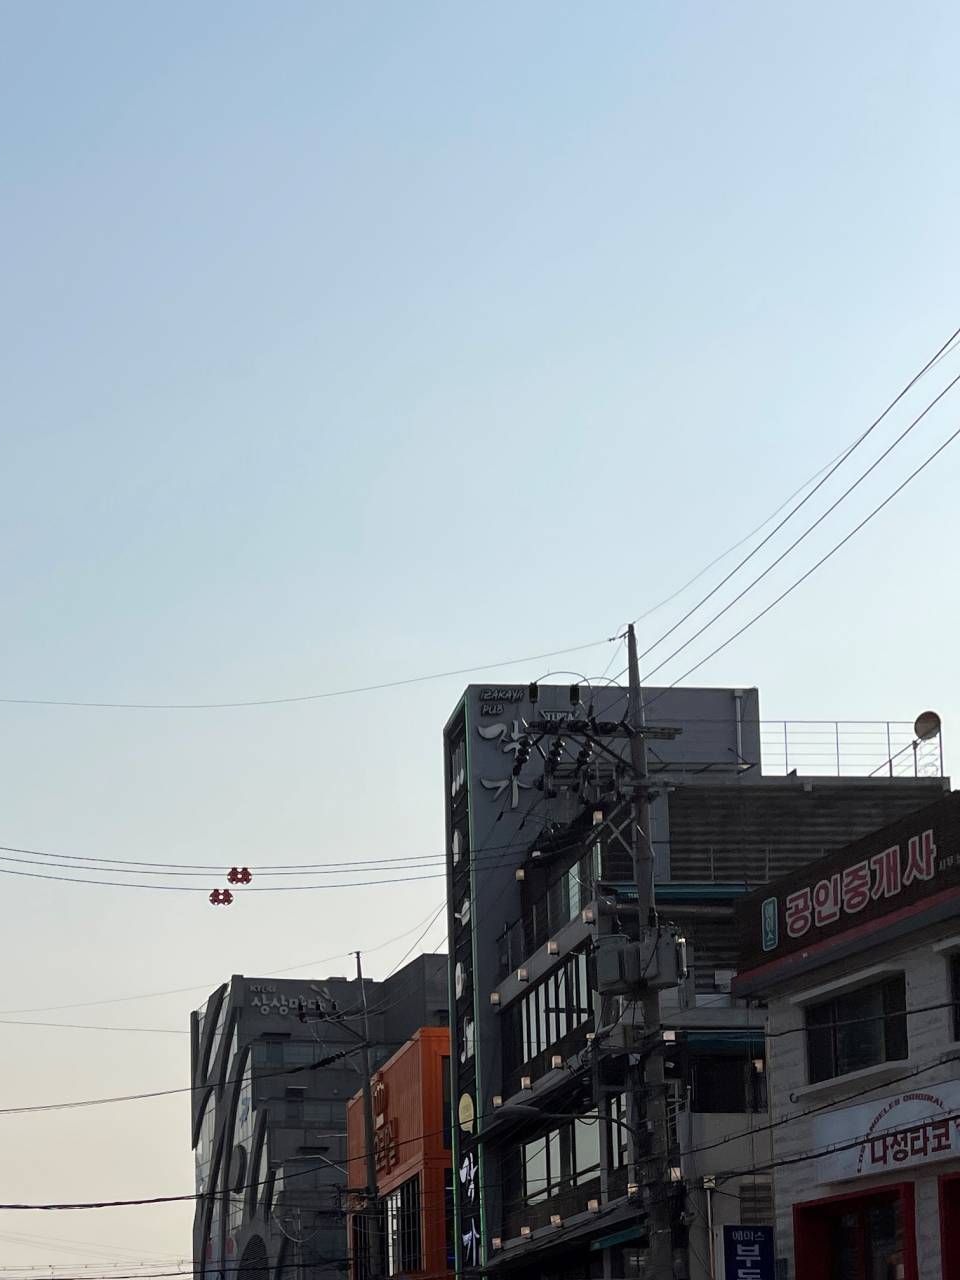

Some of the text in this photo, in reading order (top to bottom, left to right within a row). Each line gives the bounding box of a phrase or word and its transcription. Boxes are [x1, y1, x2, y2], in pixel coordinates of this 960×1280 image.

[480, 687, 525, 701] IZAKAYA
[481, 703, 504, 716] PUB
[785, 828, 937, 938] 공인중개사
[732, 1230, 765, 1241] 에이스
